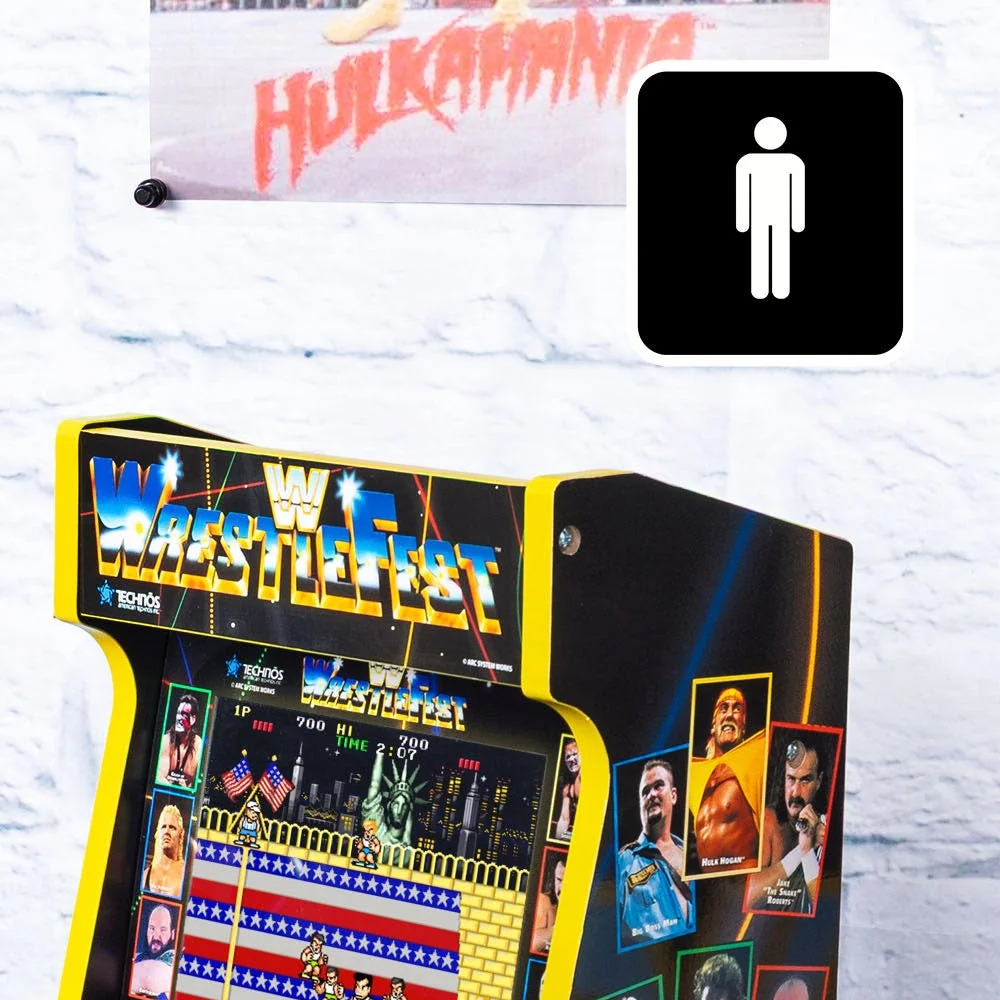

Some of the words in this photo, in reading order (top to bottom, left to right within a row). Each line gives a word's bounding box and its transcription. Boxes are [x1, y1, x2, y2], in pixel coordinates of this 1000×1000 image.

[89, 451, 502, 636] WRESTLEFEST
[234, 704, 251, 718] 1P
[296, 715, 326, 732] 700
[336, 723, 353, 737] HI
[399, 735, 429, 751] 700
[335, 735, 369, 753] TIME
[375, 742, 417, 761] 2:07
